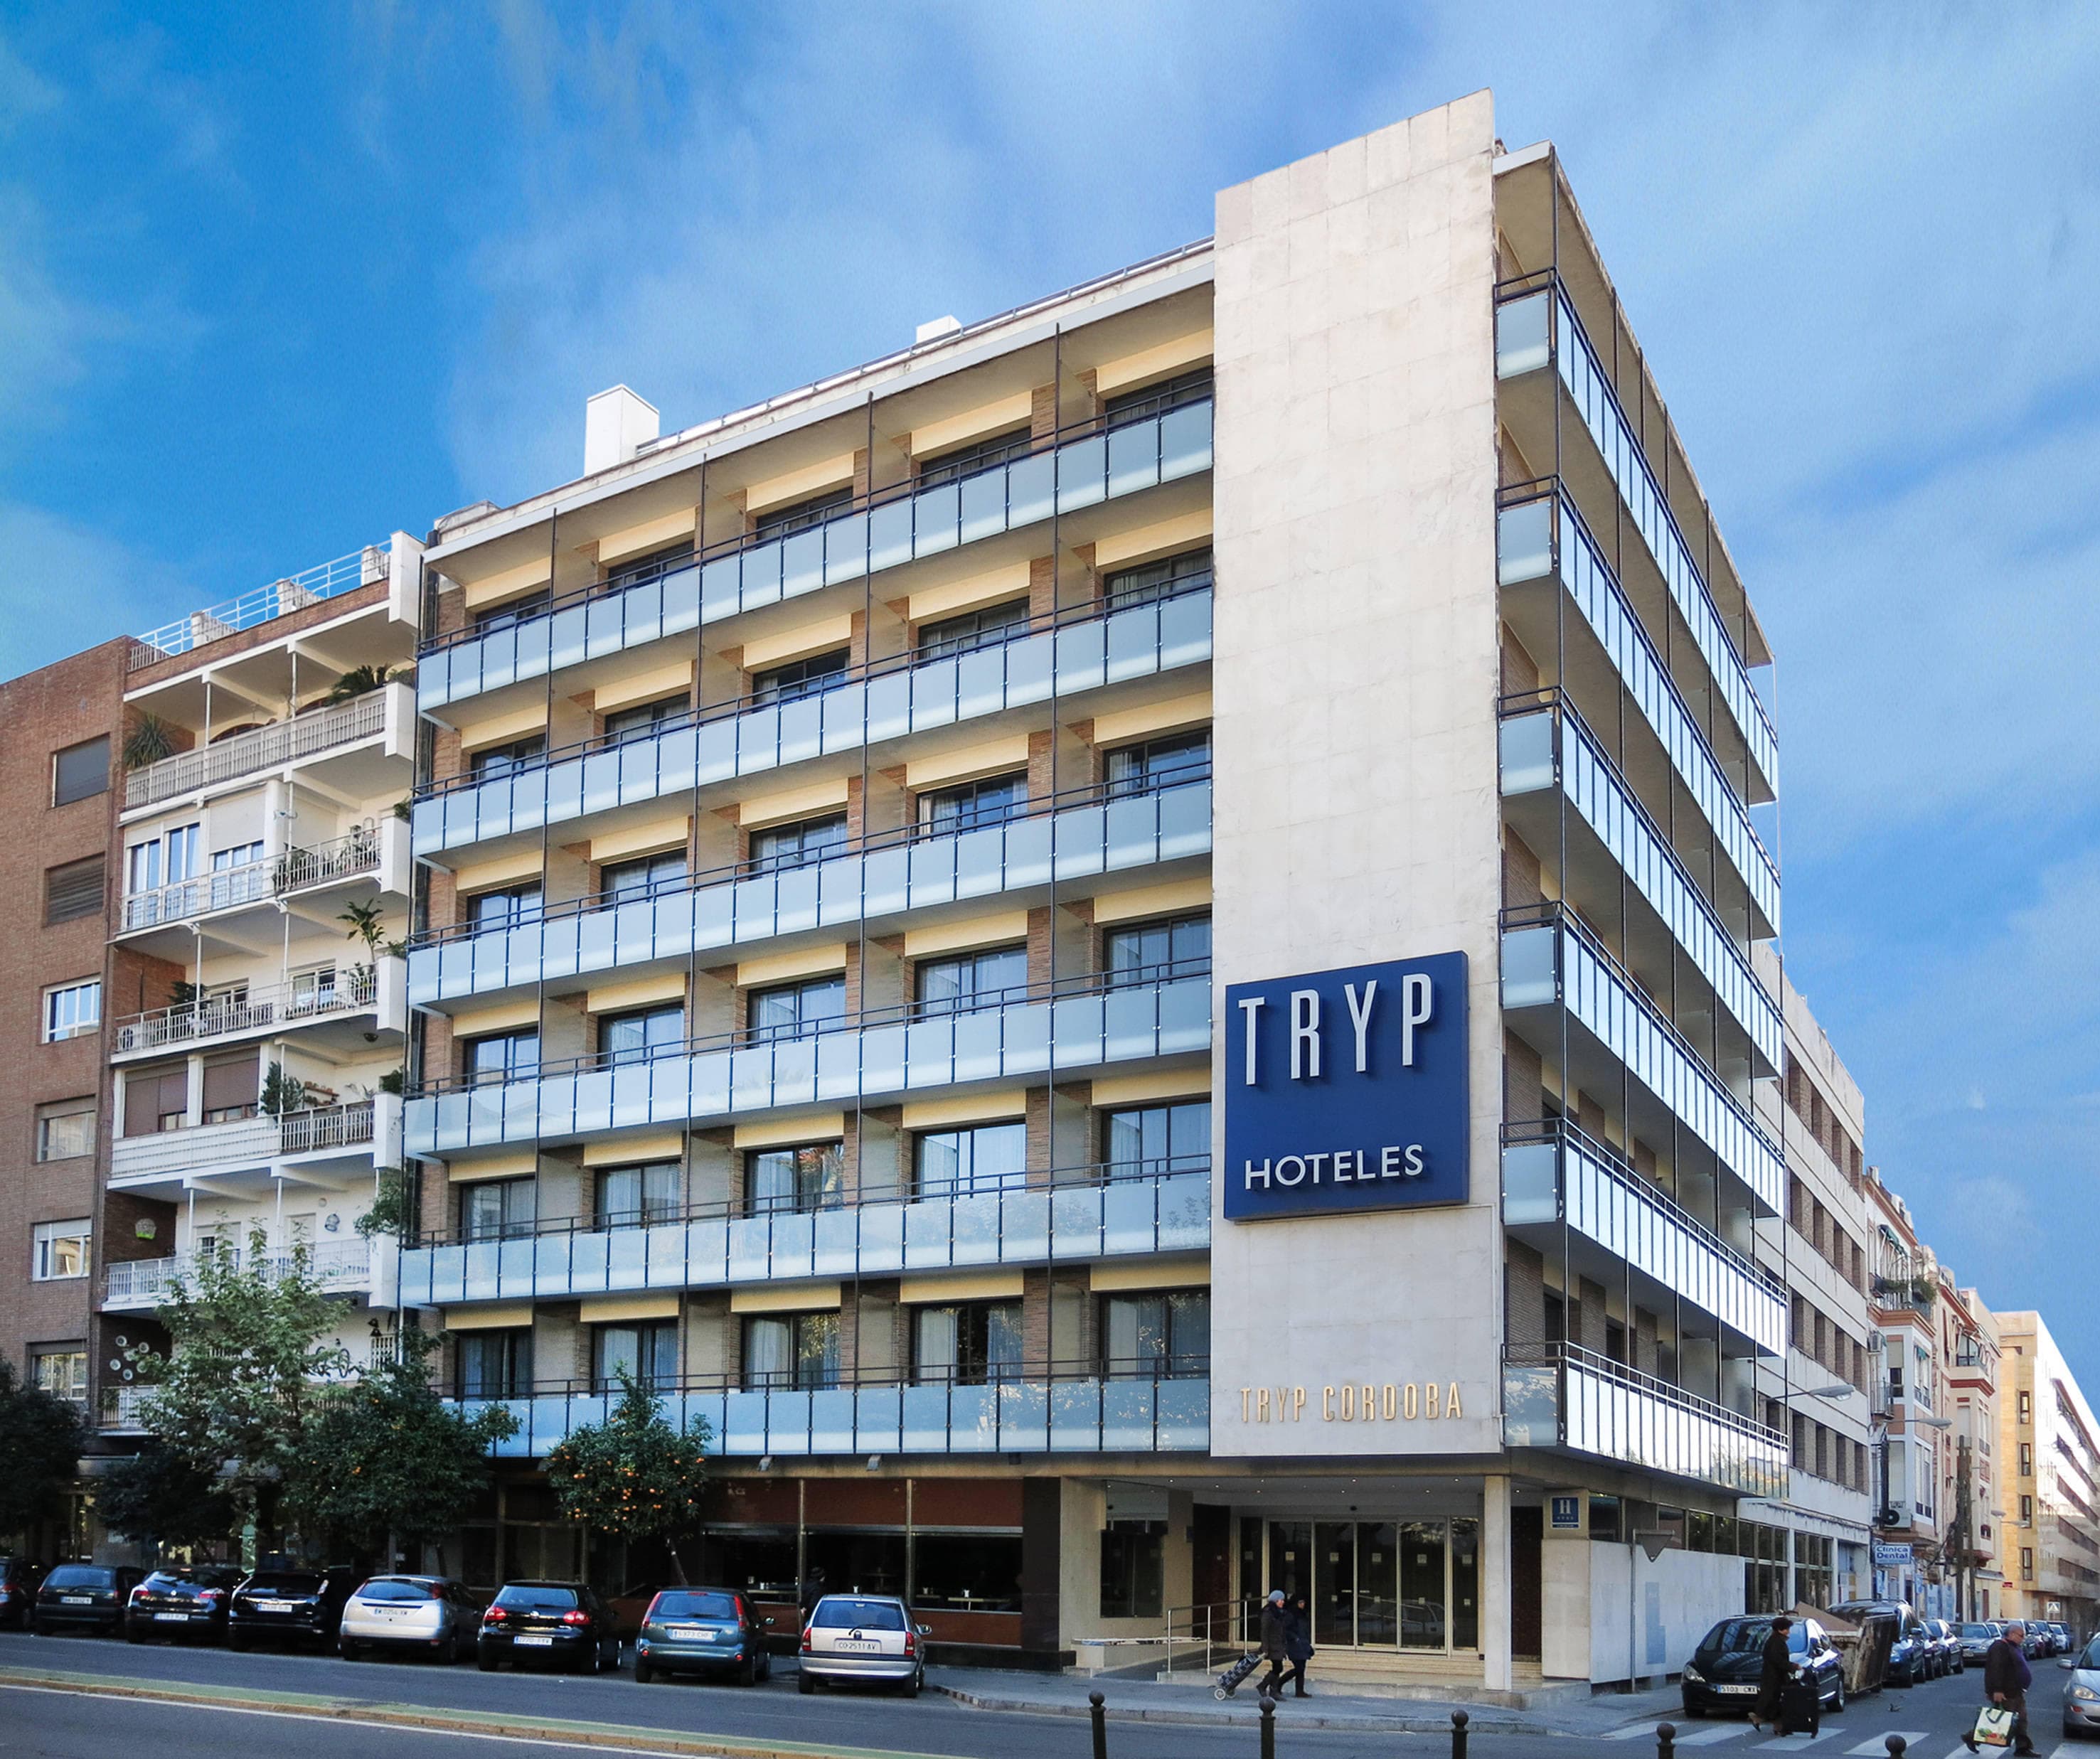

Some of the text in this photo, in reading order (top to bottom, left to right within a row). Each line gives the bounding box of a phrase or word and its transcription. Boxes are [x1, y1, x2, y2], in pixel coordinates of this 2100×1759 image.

[1238, 973, 1433, 1086] TRYP
[1245, 1144, 1424, 1189] HOTELES
[1240, 1382, 1462, 1422] TRYP CORDOBA
[1559, 1499, 1572, 1514] H
